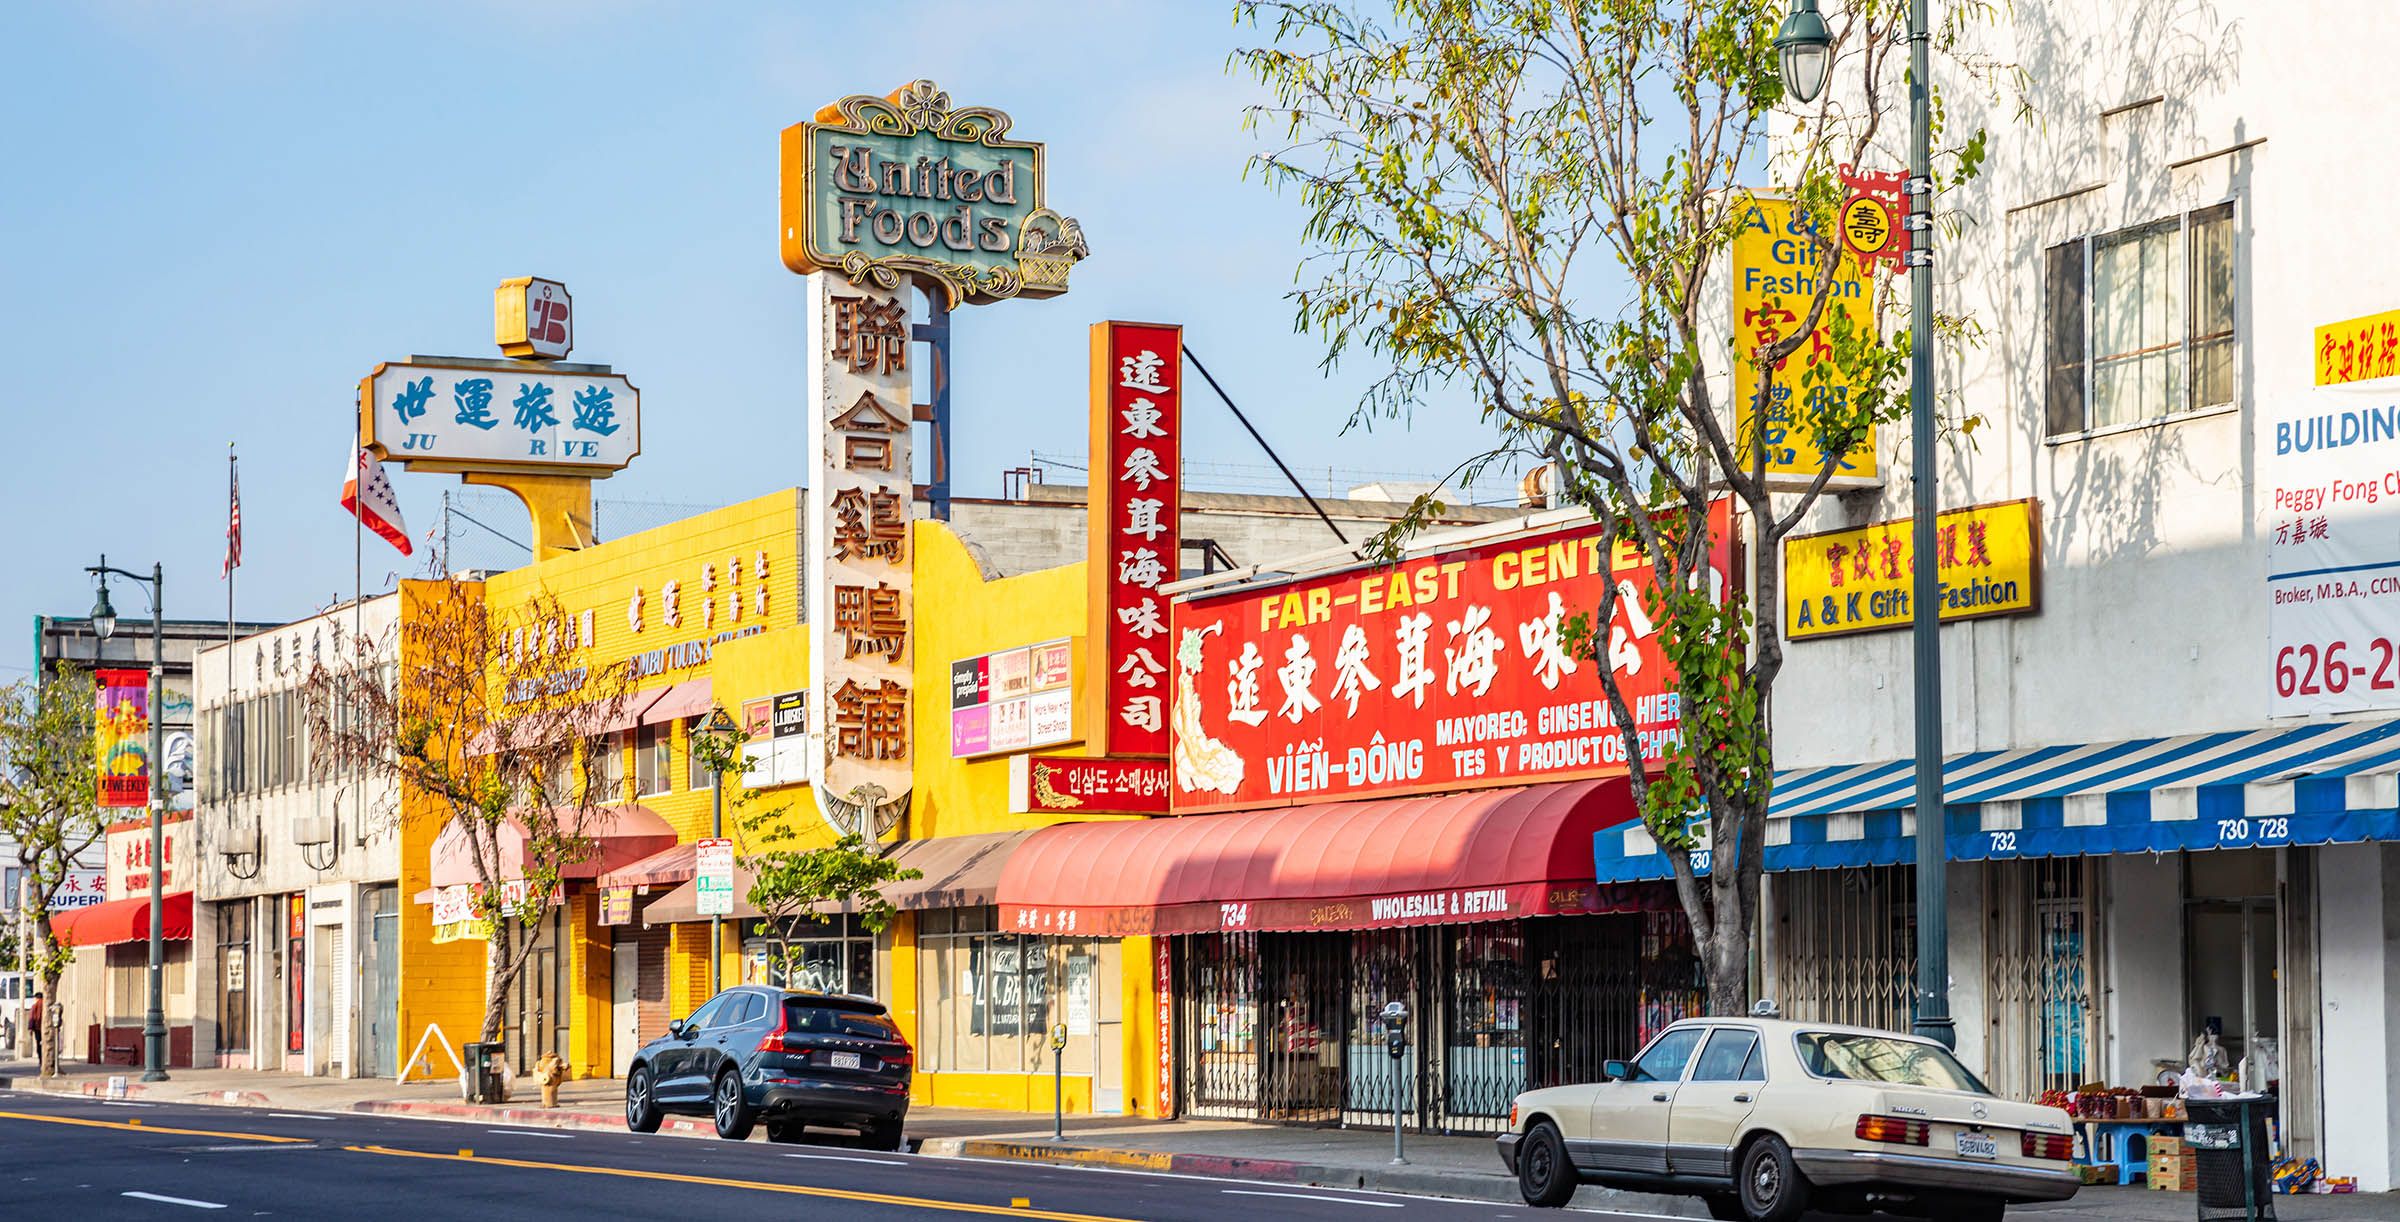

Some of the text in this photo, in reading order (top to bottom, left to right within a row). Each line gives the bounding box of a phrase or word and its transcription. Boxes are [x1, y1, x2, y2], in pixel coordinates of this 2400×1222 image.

[830, 145, 1017, 205] United
[838, 197, 1011, 252] Foods
[1772, 239, 1822, 266] Gif
[393, 376, 621, 436] 世運旅遊
[2276, 405, 2400, 456] BUILDIN
[2275, 484, 2326, 513] Peggy
[2333, 476, 2378, 505] Fong
[1826, 519, 1992, 587] 富成禮服裝
[1261, 564, 1467, 632] FAR-EAST
[1797, 575, 2018, 628] A & K Gift Fashion
[2275, 585, 2314, 606] Broker,
[2317, 581, 2368, 601] M.B.A.,
[2275, 636, 2400, 698] 626-2
[1436, 710, 1528, 747] MAYOREO:
[1636, 691, 1681, 724] HIER
[1452, 749, 1486, 778] TES
[1496, 746, 1510, 774] Y
[1639, 728, 1689, 760] CHIN
[1990, 831, 2017, 853] 732
[2217, 817, 2289, 841] 730 728
[1690, 851, 1710, 870] 730
[48, 895, 104, 906] SUPERI
[1220, 903, 1247, 927] 734
[1371, 893, 1446, 921] WHOLESALE
[1450, 891, 1460, 915] &
[1464, 889, 1509, 915] RETAIL
[1002, 972, 1048, 1006] BRSKE
